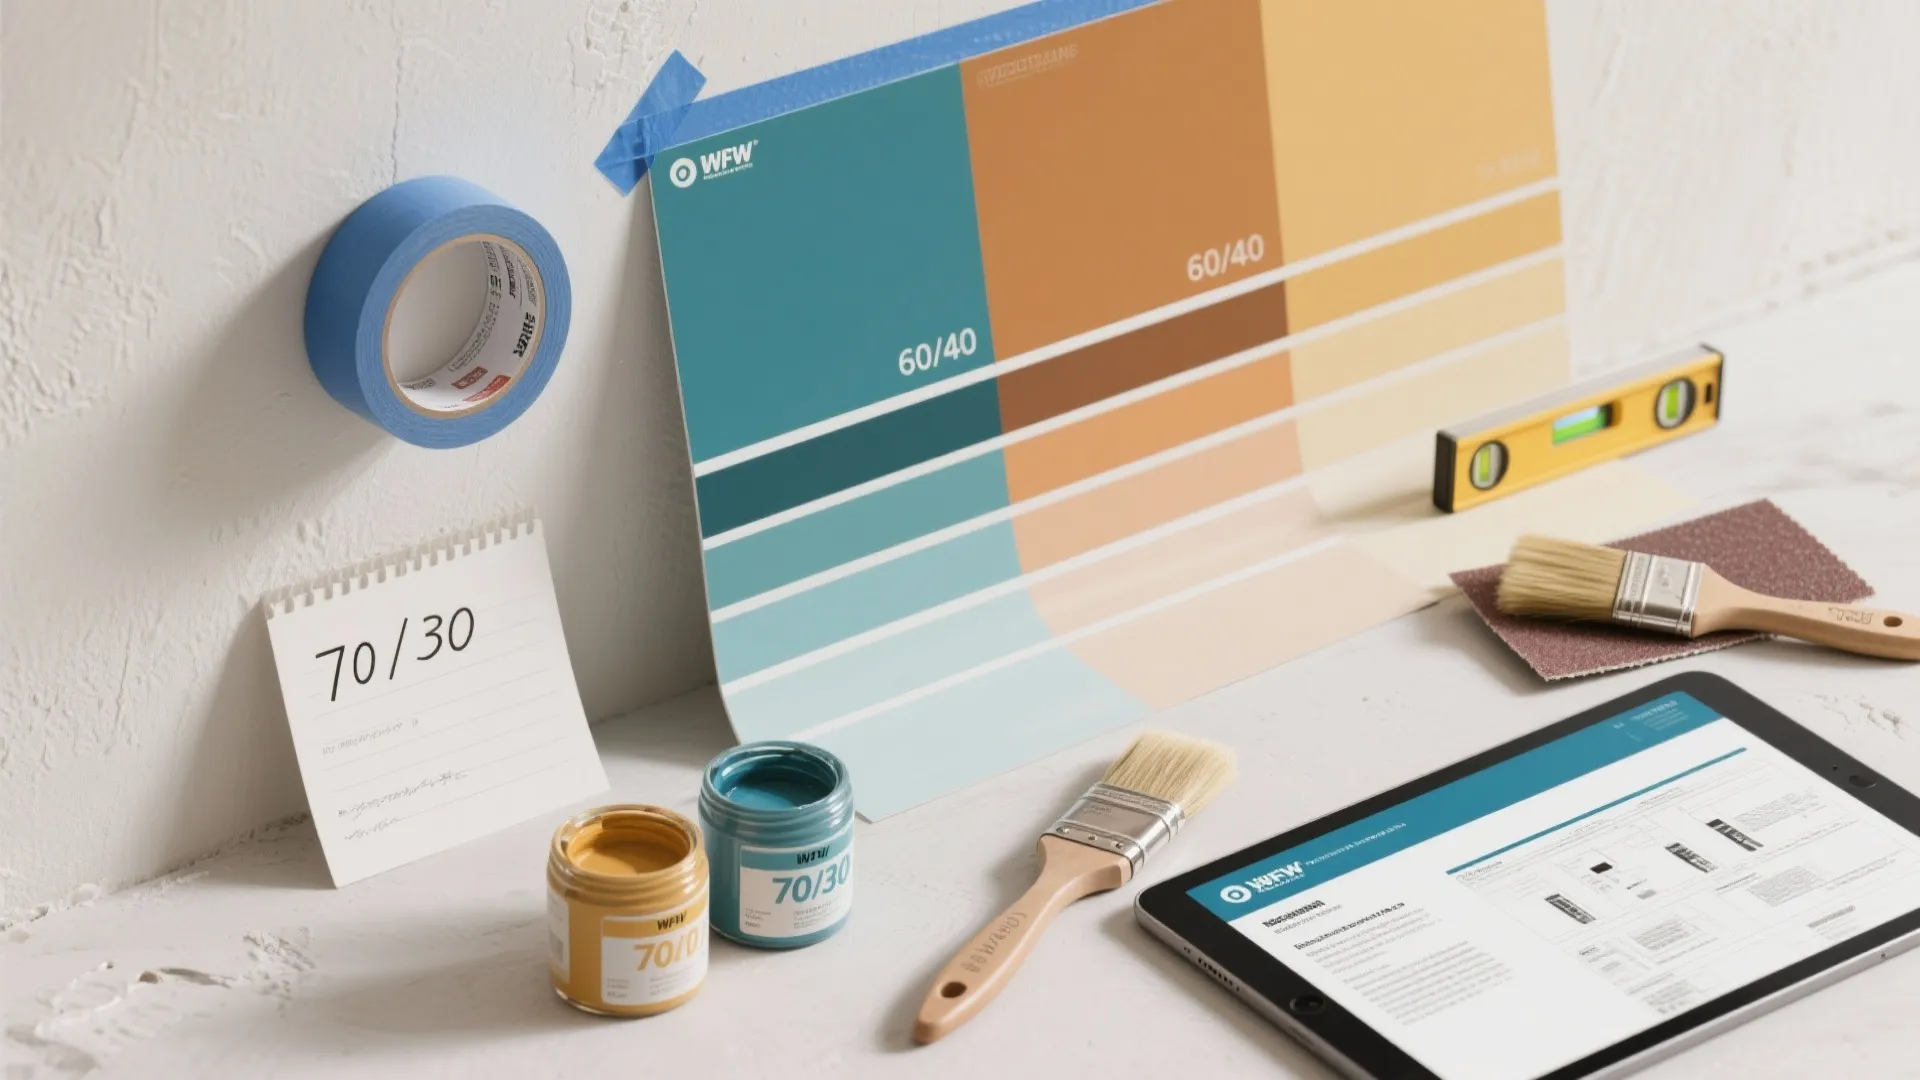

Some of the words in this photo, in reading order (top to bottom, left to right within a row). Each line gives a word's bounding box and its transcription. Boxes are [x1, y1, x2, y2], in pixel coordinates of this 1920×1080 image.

[1187, 234, 1264, 281] 60/40
[898, 327, 977, 376] 60/40
[772, 855, 850, 904] 70/30
[634, 928, 699, 973] 70/0
